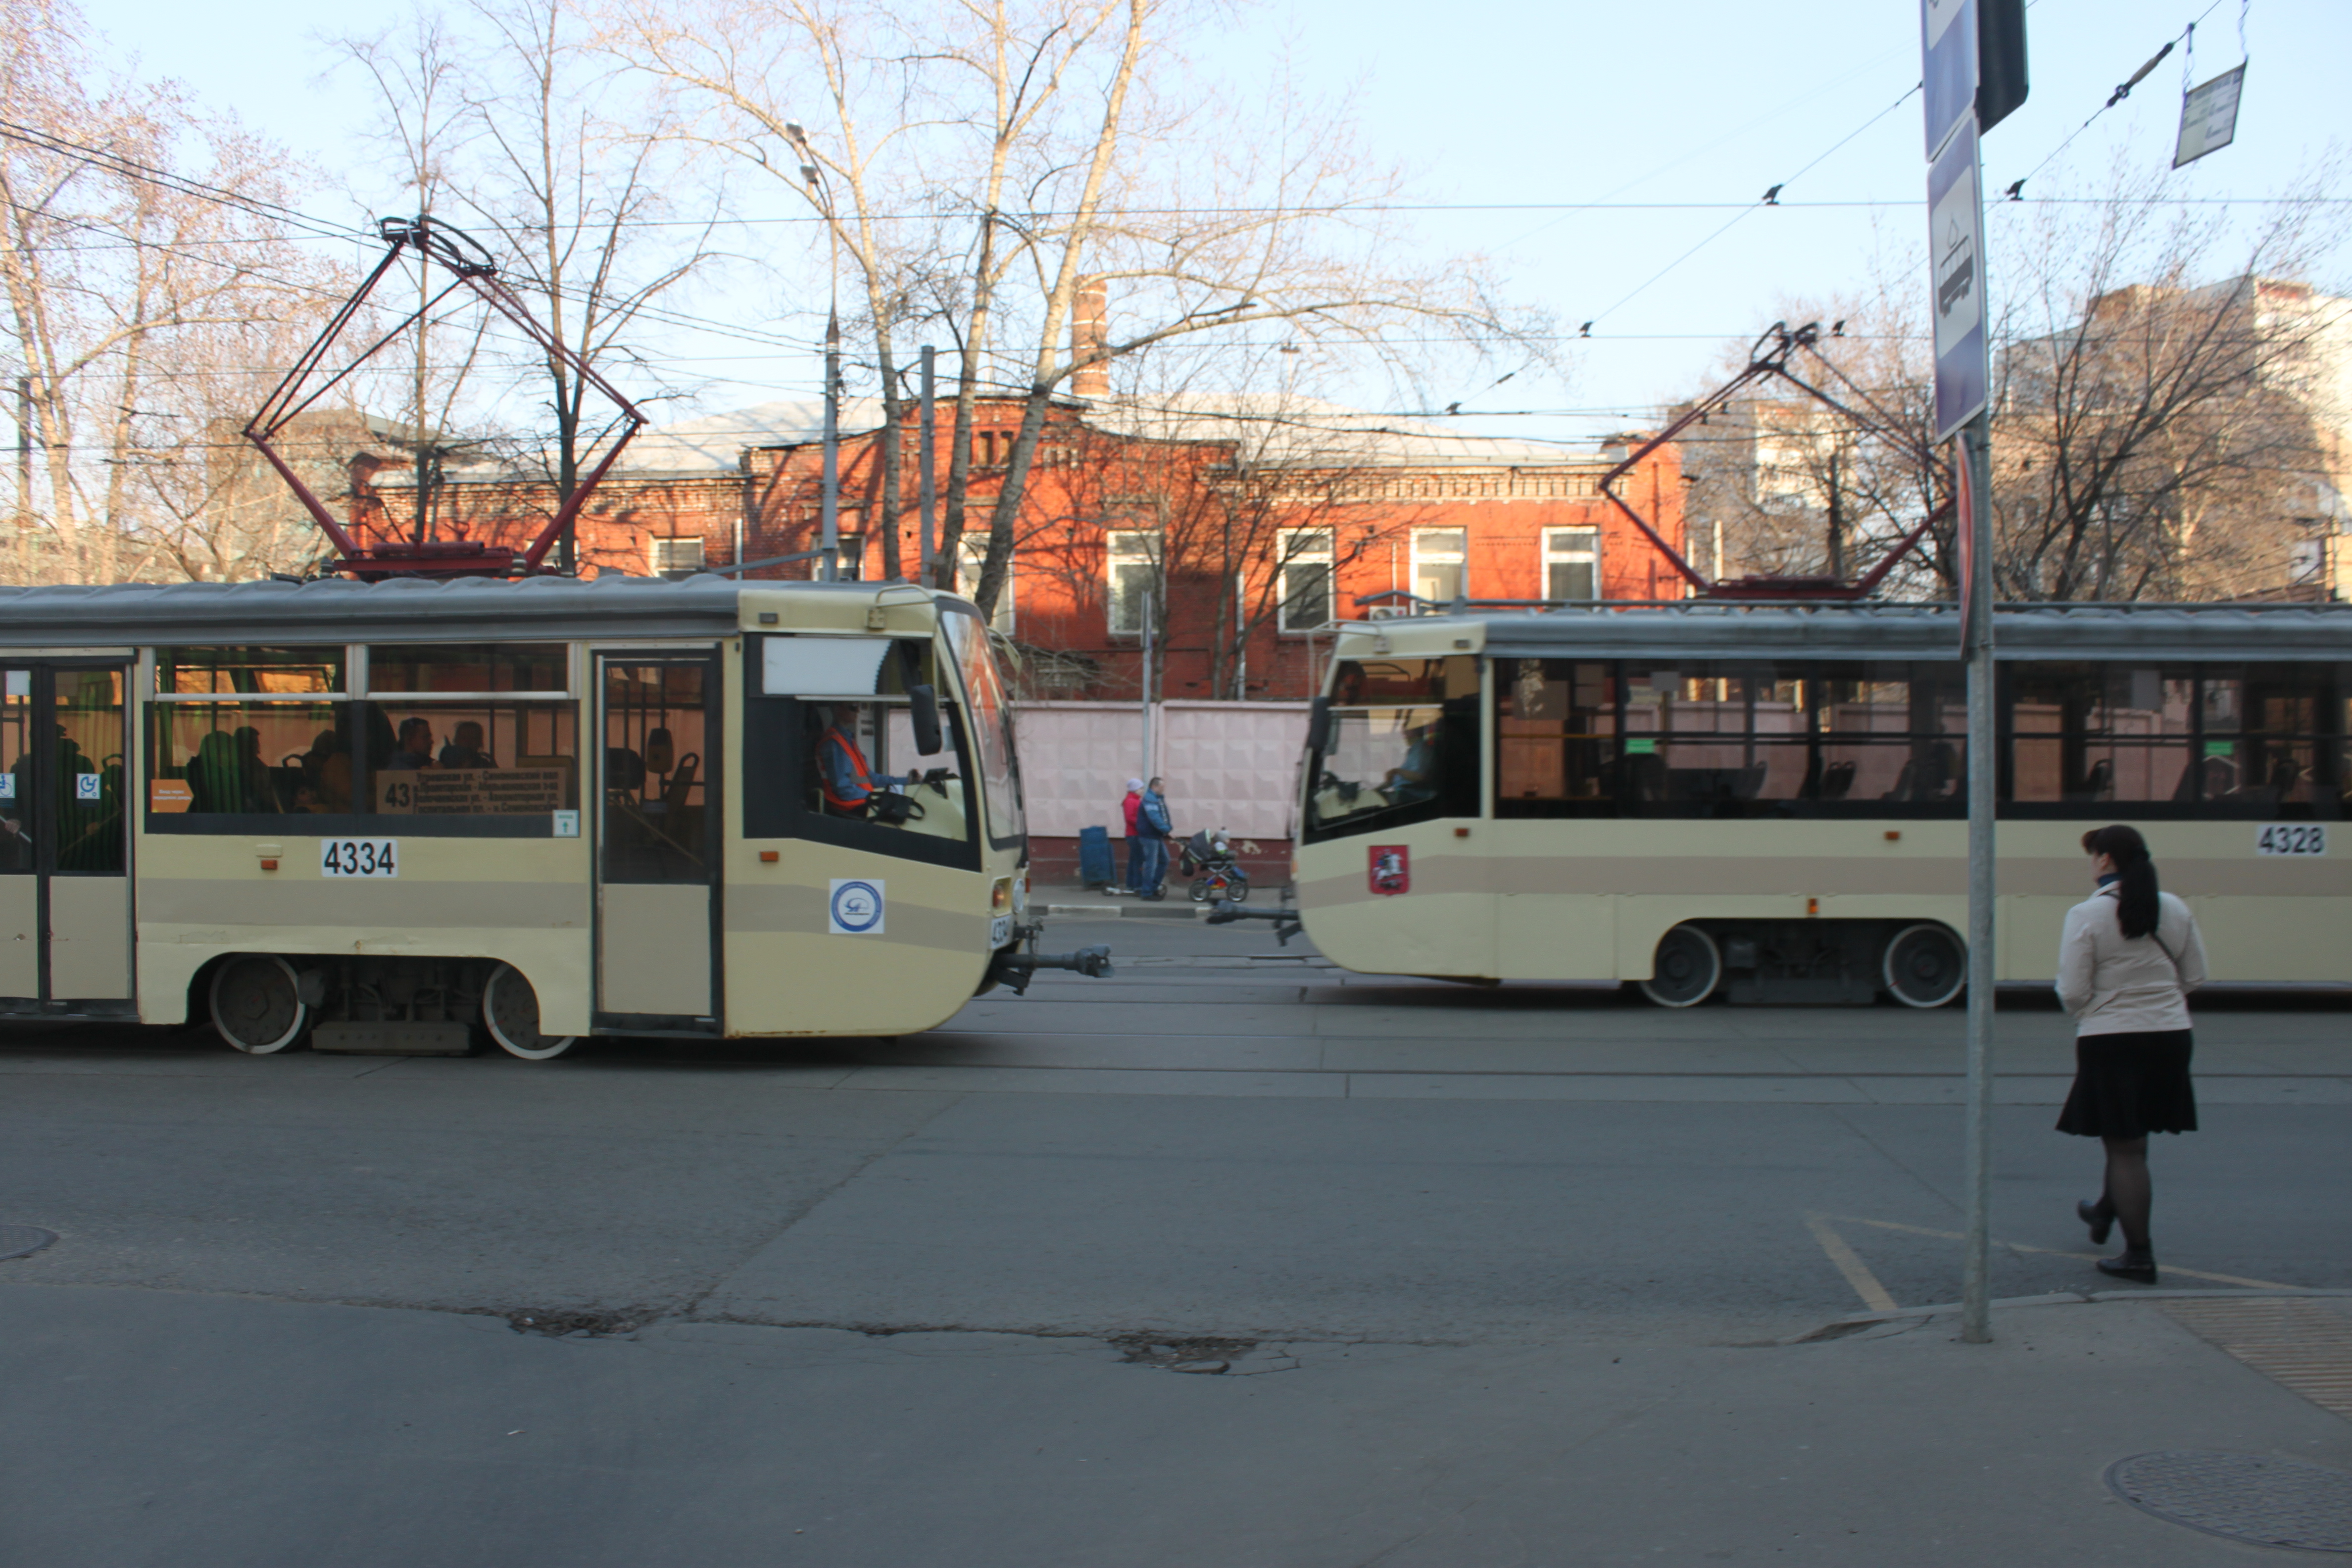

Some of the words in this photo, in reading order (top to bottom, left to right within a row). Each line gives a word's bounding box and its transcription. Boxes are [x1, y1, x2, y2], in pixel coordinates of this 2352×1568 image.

[385, 784, 409, 807] 43
[2258, 827, 2324, 853] 4328
[324, 842, 395, 874] 4334
